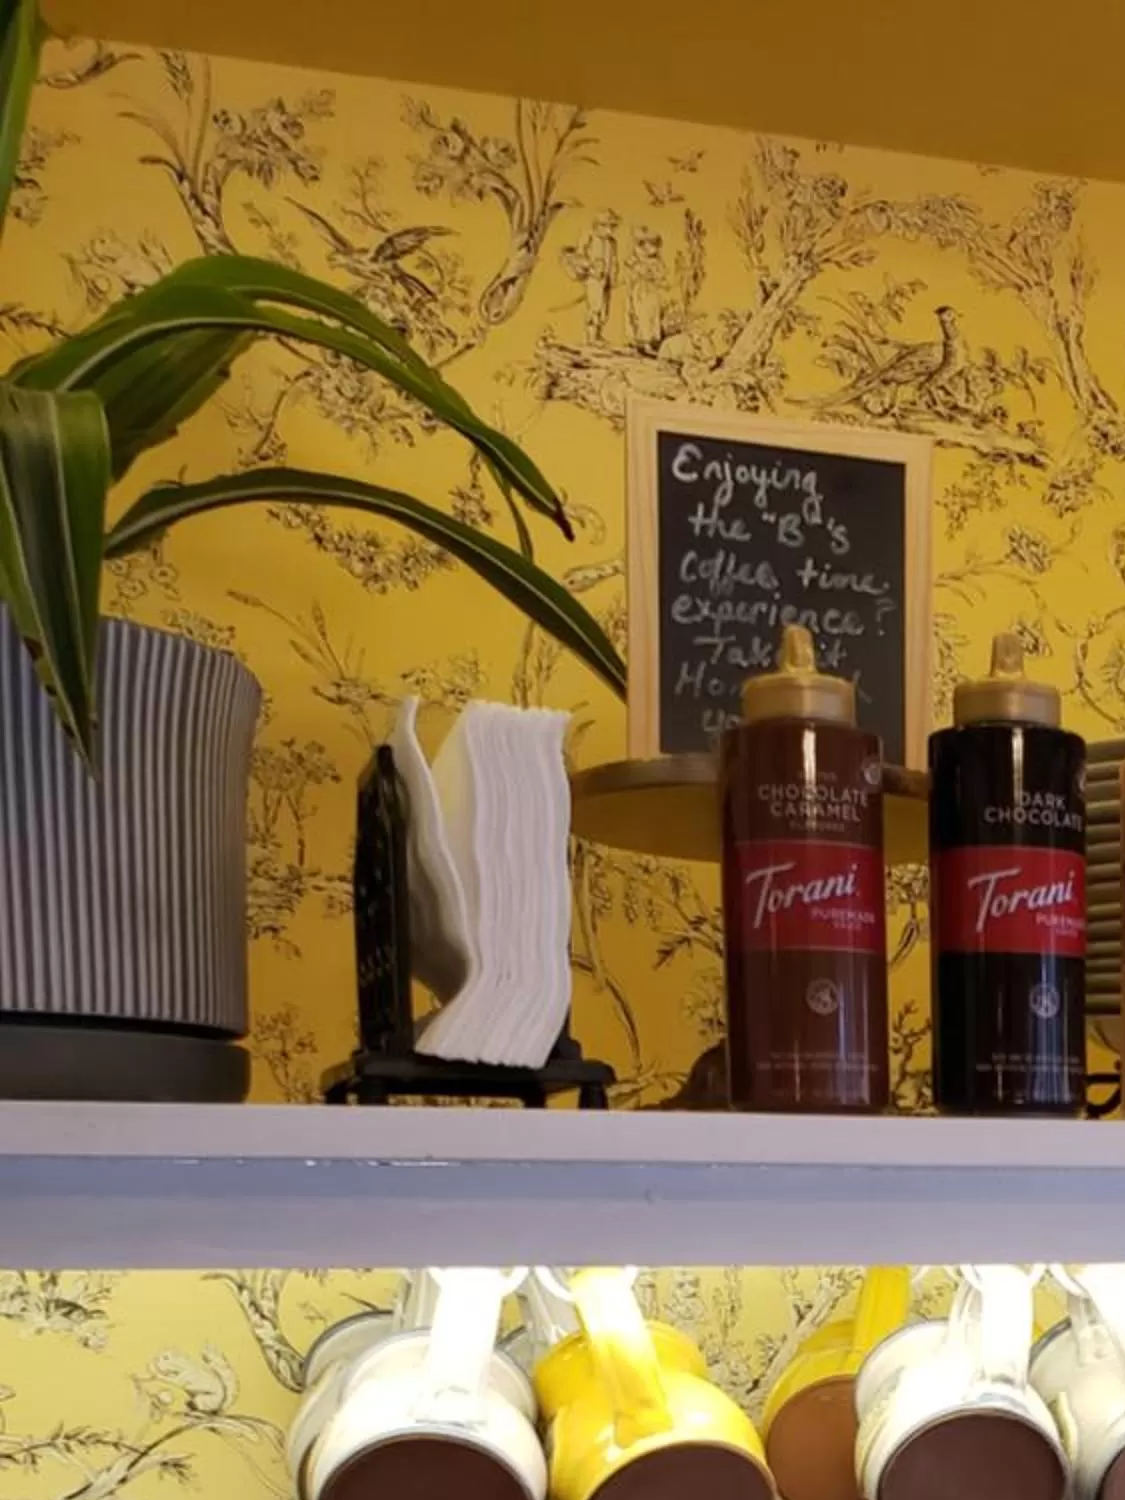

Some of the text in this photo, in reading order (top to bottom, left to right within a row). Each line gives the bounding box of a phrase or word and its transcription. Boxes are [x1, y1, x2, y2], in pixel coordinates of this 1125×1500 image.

[672, 443, 824, 507] Enjoying
[688, 502, 751, 539] the
[693, 635, 776, 668] Tak
[758, 783, 868, 808] CHOCOLATE
[770, 801, 861, 822] CARAMEL
[1019, 792, 1067, 809] DARK
[746, 863, 859, 928] Torani
[967, 867, 1077, 932] Torani
